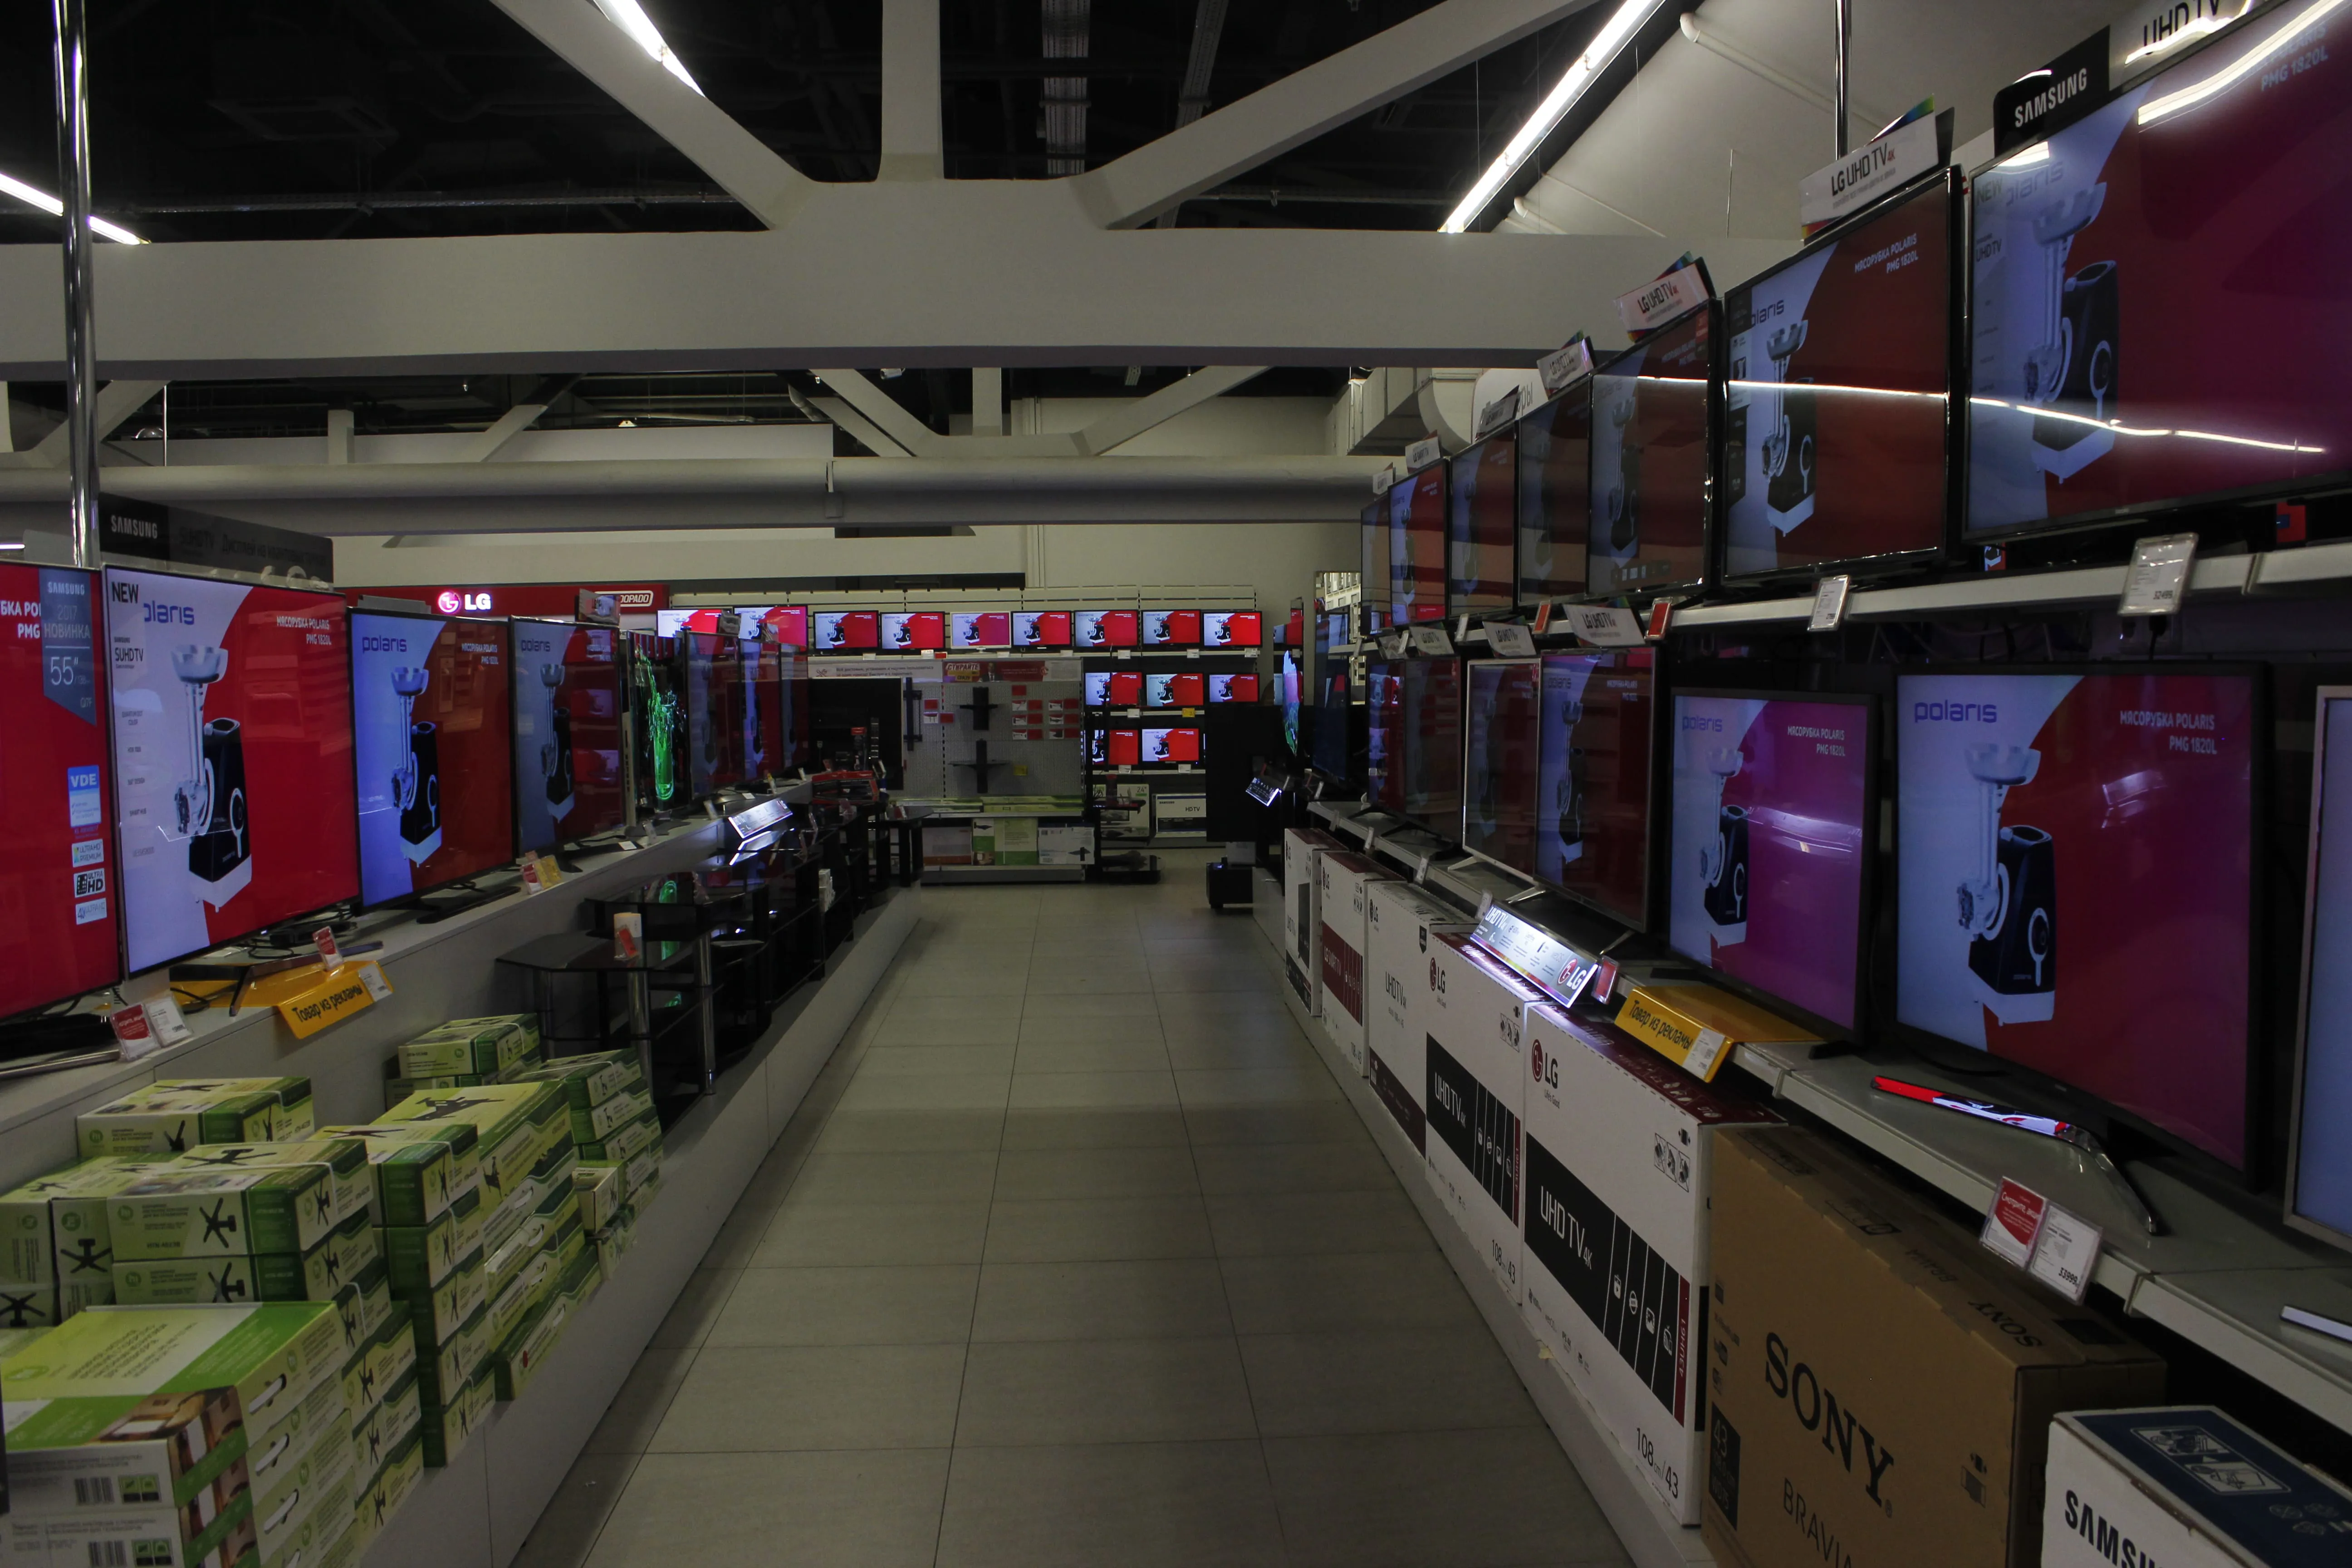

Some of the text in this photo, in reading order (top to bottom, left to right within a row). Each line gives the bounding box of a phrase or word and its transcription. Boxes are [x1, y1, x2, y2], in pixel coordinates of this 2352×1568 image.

[2014, 68, 2087, 128] SAMSUNG
[1831, 171, 1845, 196] LG
[1846, 154, 1871, 186] UHD
[1872, 143, 1888, 172] TV
[1976, 177, 2003, 206] NEW
[1891, 233, 1917, 255] POLARIS
[1886, 260, 1900, 274] PMG
[1637, 298, 1649, 314] LG
[1649, 286, 1665, 309] UHD
[1662, 280, 1674, 300] TV
[110, 514, 158, 539] SAMSUNG
[48, 582, 85, 595] SAMSUNG
[112, 581, 139, 603] NEW
[57, 605, 78, 621] 2017
[464, 593, 492, 611] LG
[17, 623, 40, 639] PMG
[44, 623, 90, 639] НОВИНКА
[276, 615, 330, 631] МЯСОРУБКА POLARIS
[1582, 615, 1592, 629] LG
[1592, 614, 1604, 627] UHD
[1604, 613, 1612, 626] TV
[306, 633, 318, 644] PMG
[363, 636, 407, 654] polaris
[521, 639, 550, 652] polaris
[115, 647, 144, 662] SUHD TV
[1682, 715, 1722, 732] polaris
[1914, 701, 1997, 725] polaris
[2120, 709, 2215, 731] МЯСОРУБКА POLARIS
[1787, 725, 1845, 741] МЯСОРУБКА POLARIS
[1816, 743, 1828, 755] PMG
[2169, 735, 2217, 755] PMG 1820L
[70, 773, 97, 788] VDE
[88, 879, 104, 892] HD
[1373, 906, 1378, 922] LG
[1485, 906, 1501, 926] UHD
[1496, 912, 1509, 929] TV
[1385, 971, 1396, 1000] UHD
[1396, 979, 1403, 1006] TV
[1437, 969, 1446, 994] LG
[1566, 965, 1588, 990] LG
[292, 984, 363, 1023] Товар из рекламы
[1629, 1000, 1693, 1051] Товар из рекламы
[1544, 1052, 1558, 1089] LG
[1435, 1071, 1450, 1111] UHD
[1451, 1088, 1461, 1122] TV
[1540, 1185, 1592, 1270] UHD TV 4K
[1968, 1300, 2044, 1348] SONY
[1766, 1332, 1894, 1508] SONY
[1713, 1419, 1728, 1458] 43
